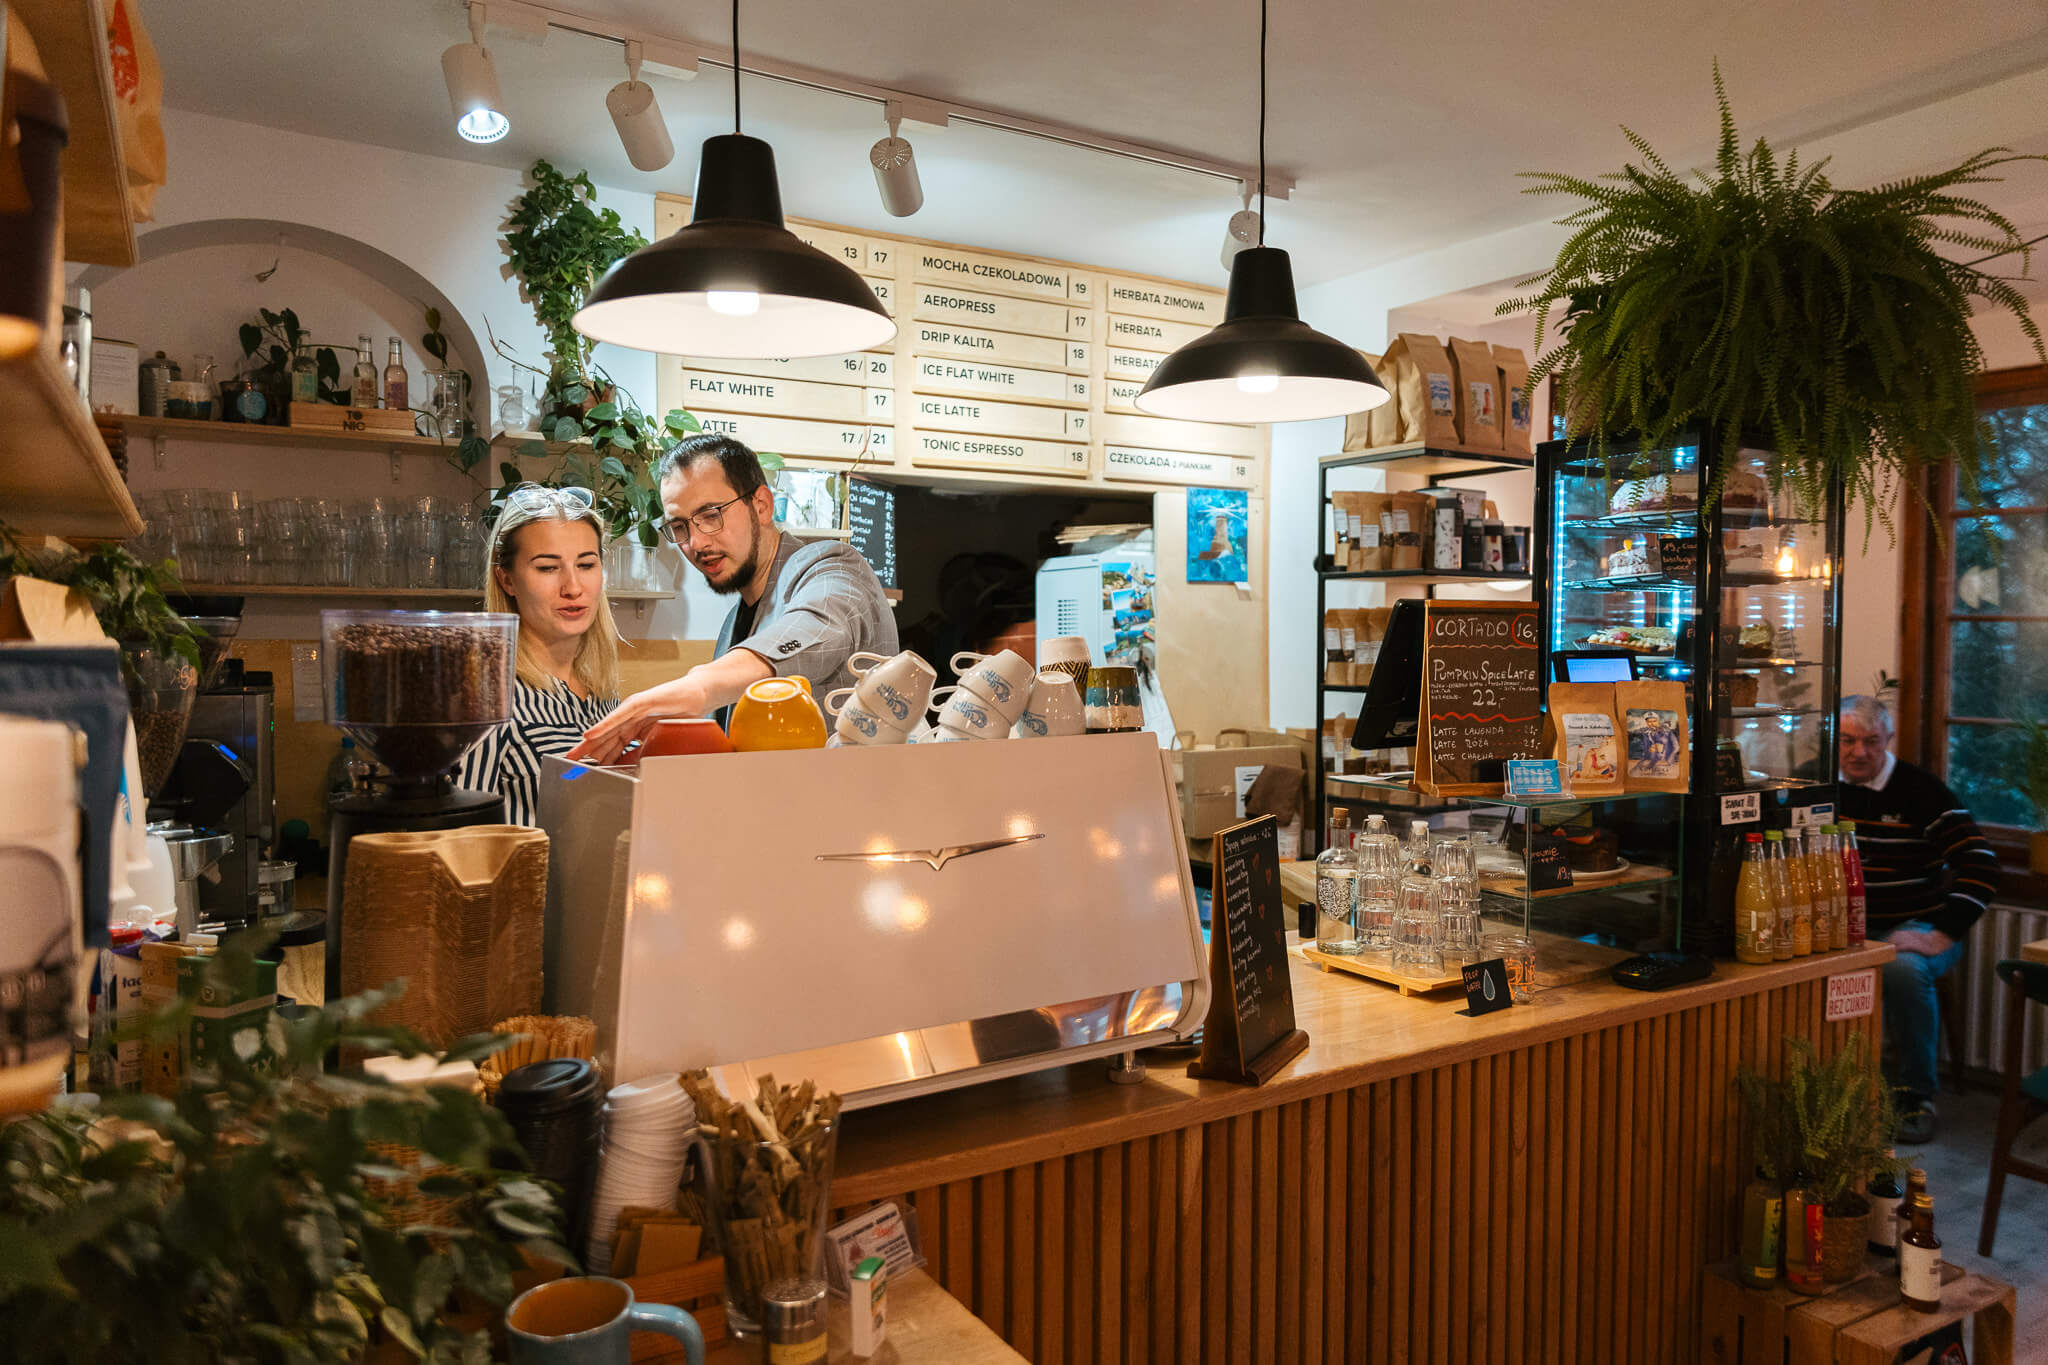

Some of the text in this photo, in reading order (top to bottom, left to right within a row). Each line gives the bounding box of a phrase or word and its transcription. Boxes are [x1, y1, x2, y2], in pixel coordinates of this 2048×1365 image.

[844, 246, 887, 264] 13 17
[922, 256, 1087, 294] MOCHA CZEKOLADOWA 19
[875, 286, 888, 298] 12
[1113, 288, 1206, 311] HERBATA ZIMOWA
[924, 294, 1087, 327] AEROPRESS 17
[1114, 322, 1163, 338] HERBATA
[921, 330, 1085, 359] DRIP KALITA 18
[871, 361, 887, 374] 20
[923, 363, 1085, 394] ICE FLAT WHITE 18
[690, 378, 887, 406] FLAT WHITE 17
[343, 421, 366, 431] NIC
[921, 402, 1085, 428] ICE LATTE 17
[702, 419, 737, 433] ATTE
[873, 433, 887, 444] 21
[923, 438, 1083, 462] TONIC ESPRESSO 18
[1109, 453, 1171, 467] CZEKOLADA
[1435, 616, 1509, 638] CORTADO
[1433, 726, 1458, 737] LATTE
[1433, 740, 1457, 750] LATTE
[1830, 974, 1873, 998] PRODUKT
[1829, 996, 1871, 1016] BEZ CUKRU
